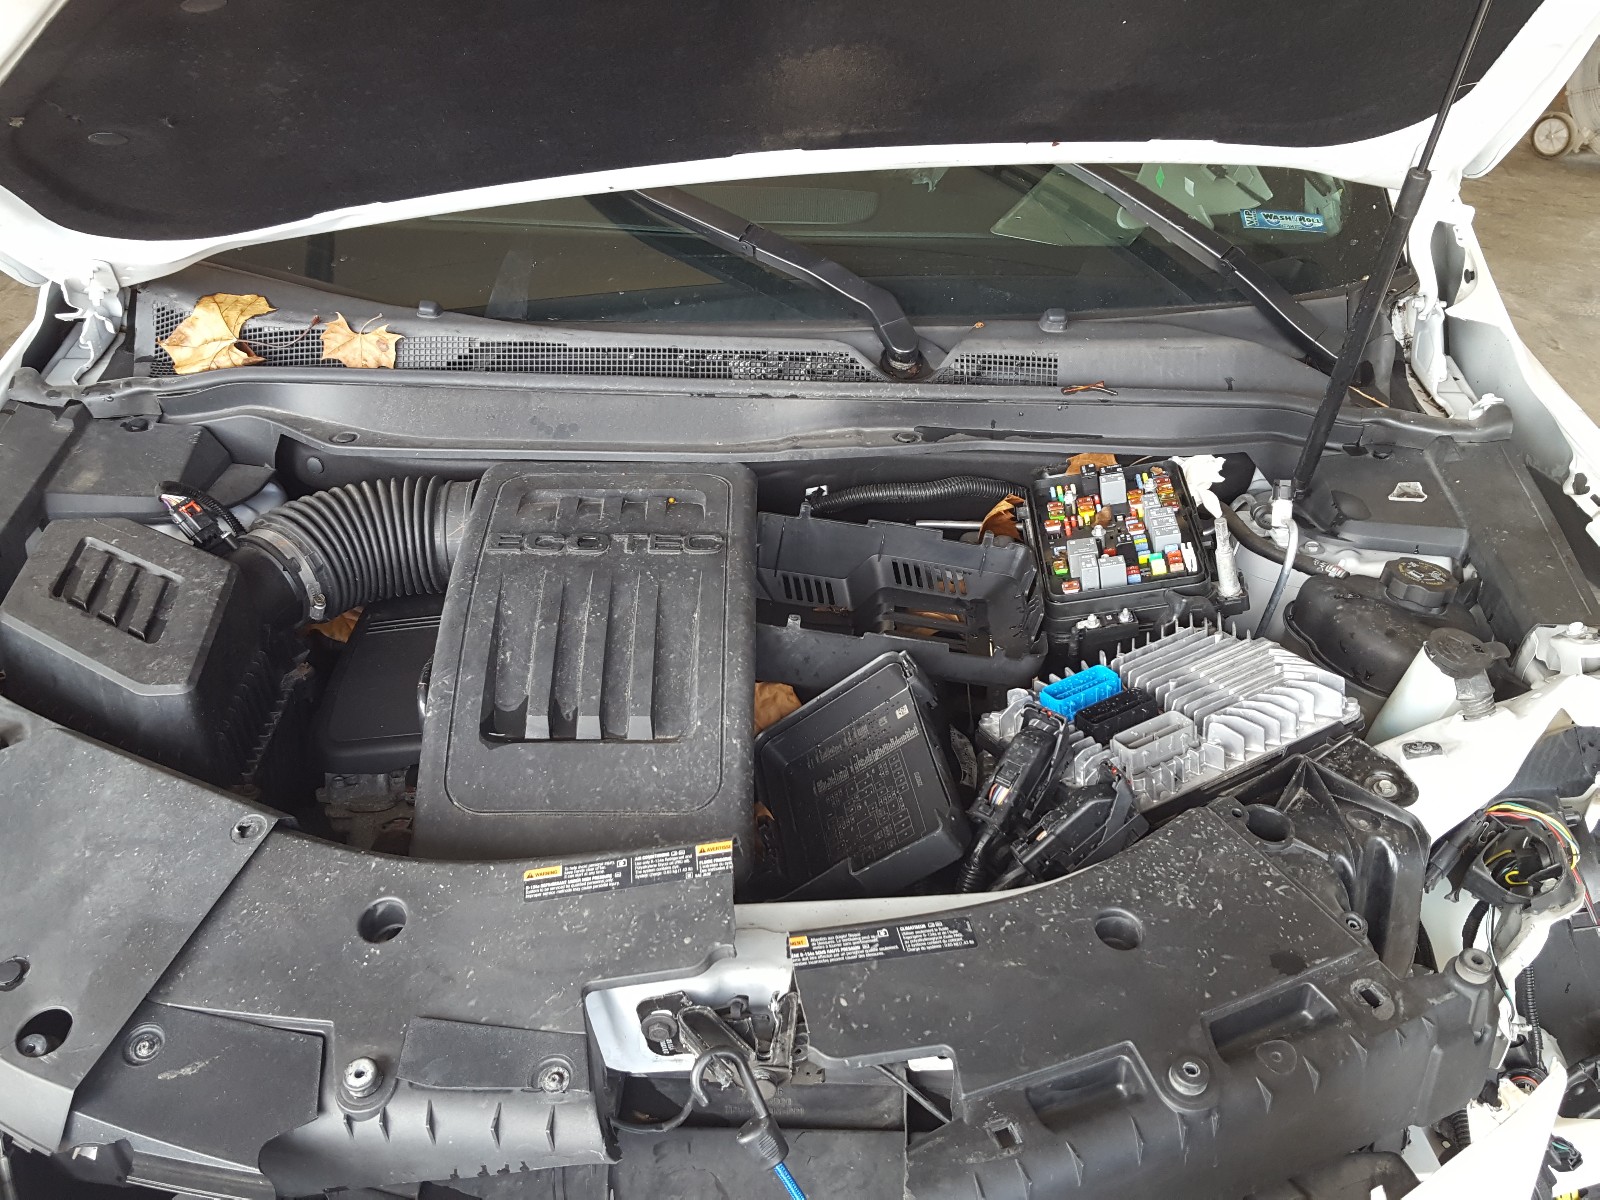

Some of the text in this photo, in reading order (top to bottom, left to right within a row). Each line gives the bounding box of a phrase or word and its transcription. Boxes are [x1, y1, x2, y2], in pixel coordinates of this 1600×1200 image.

[1244, 210, 1254, 226] VIP
[1262, 212, 1292, 221] WASH
[1298, 215, 1322, 223] ROLL
[486, 532, 725, 556] ECOTEC
